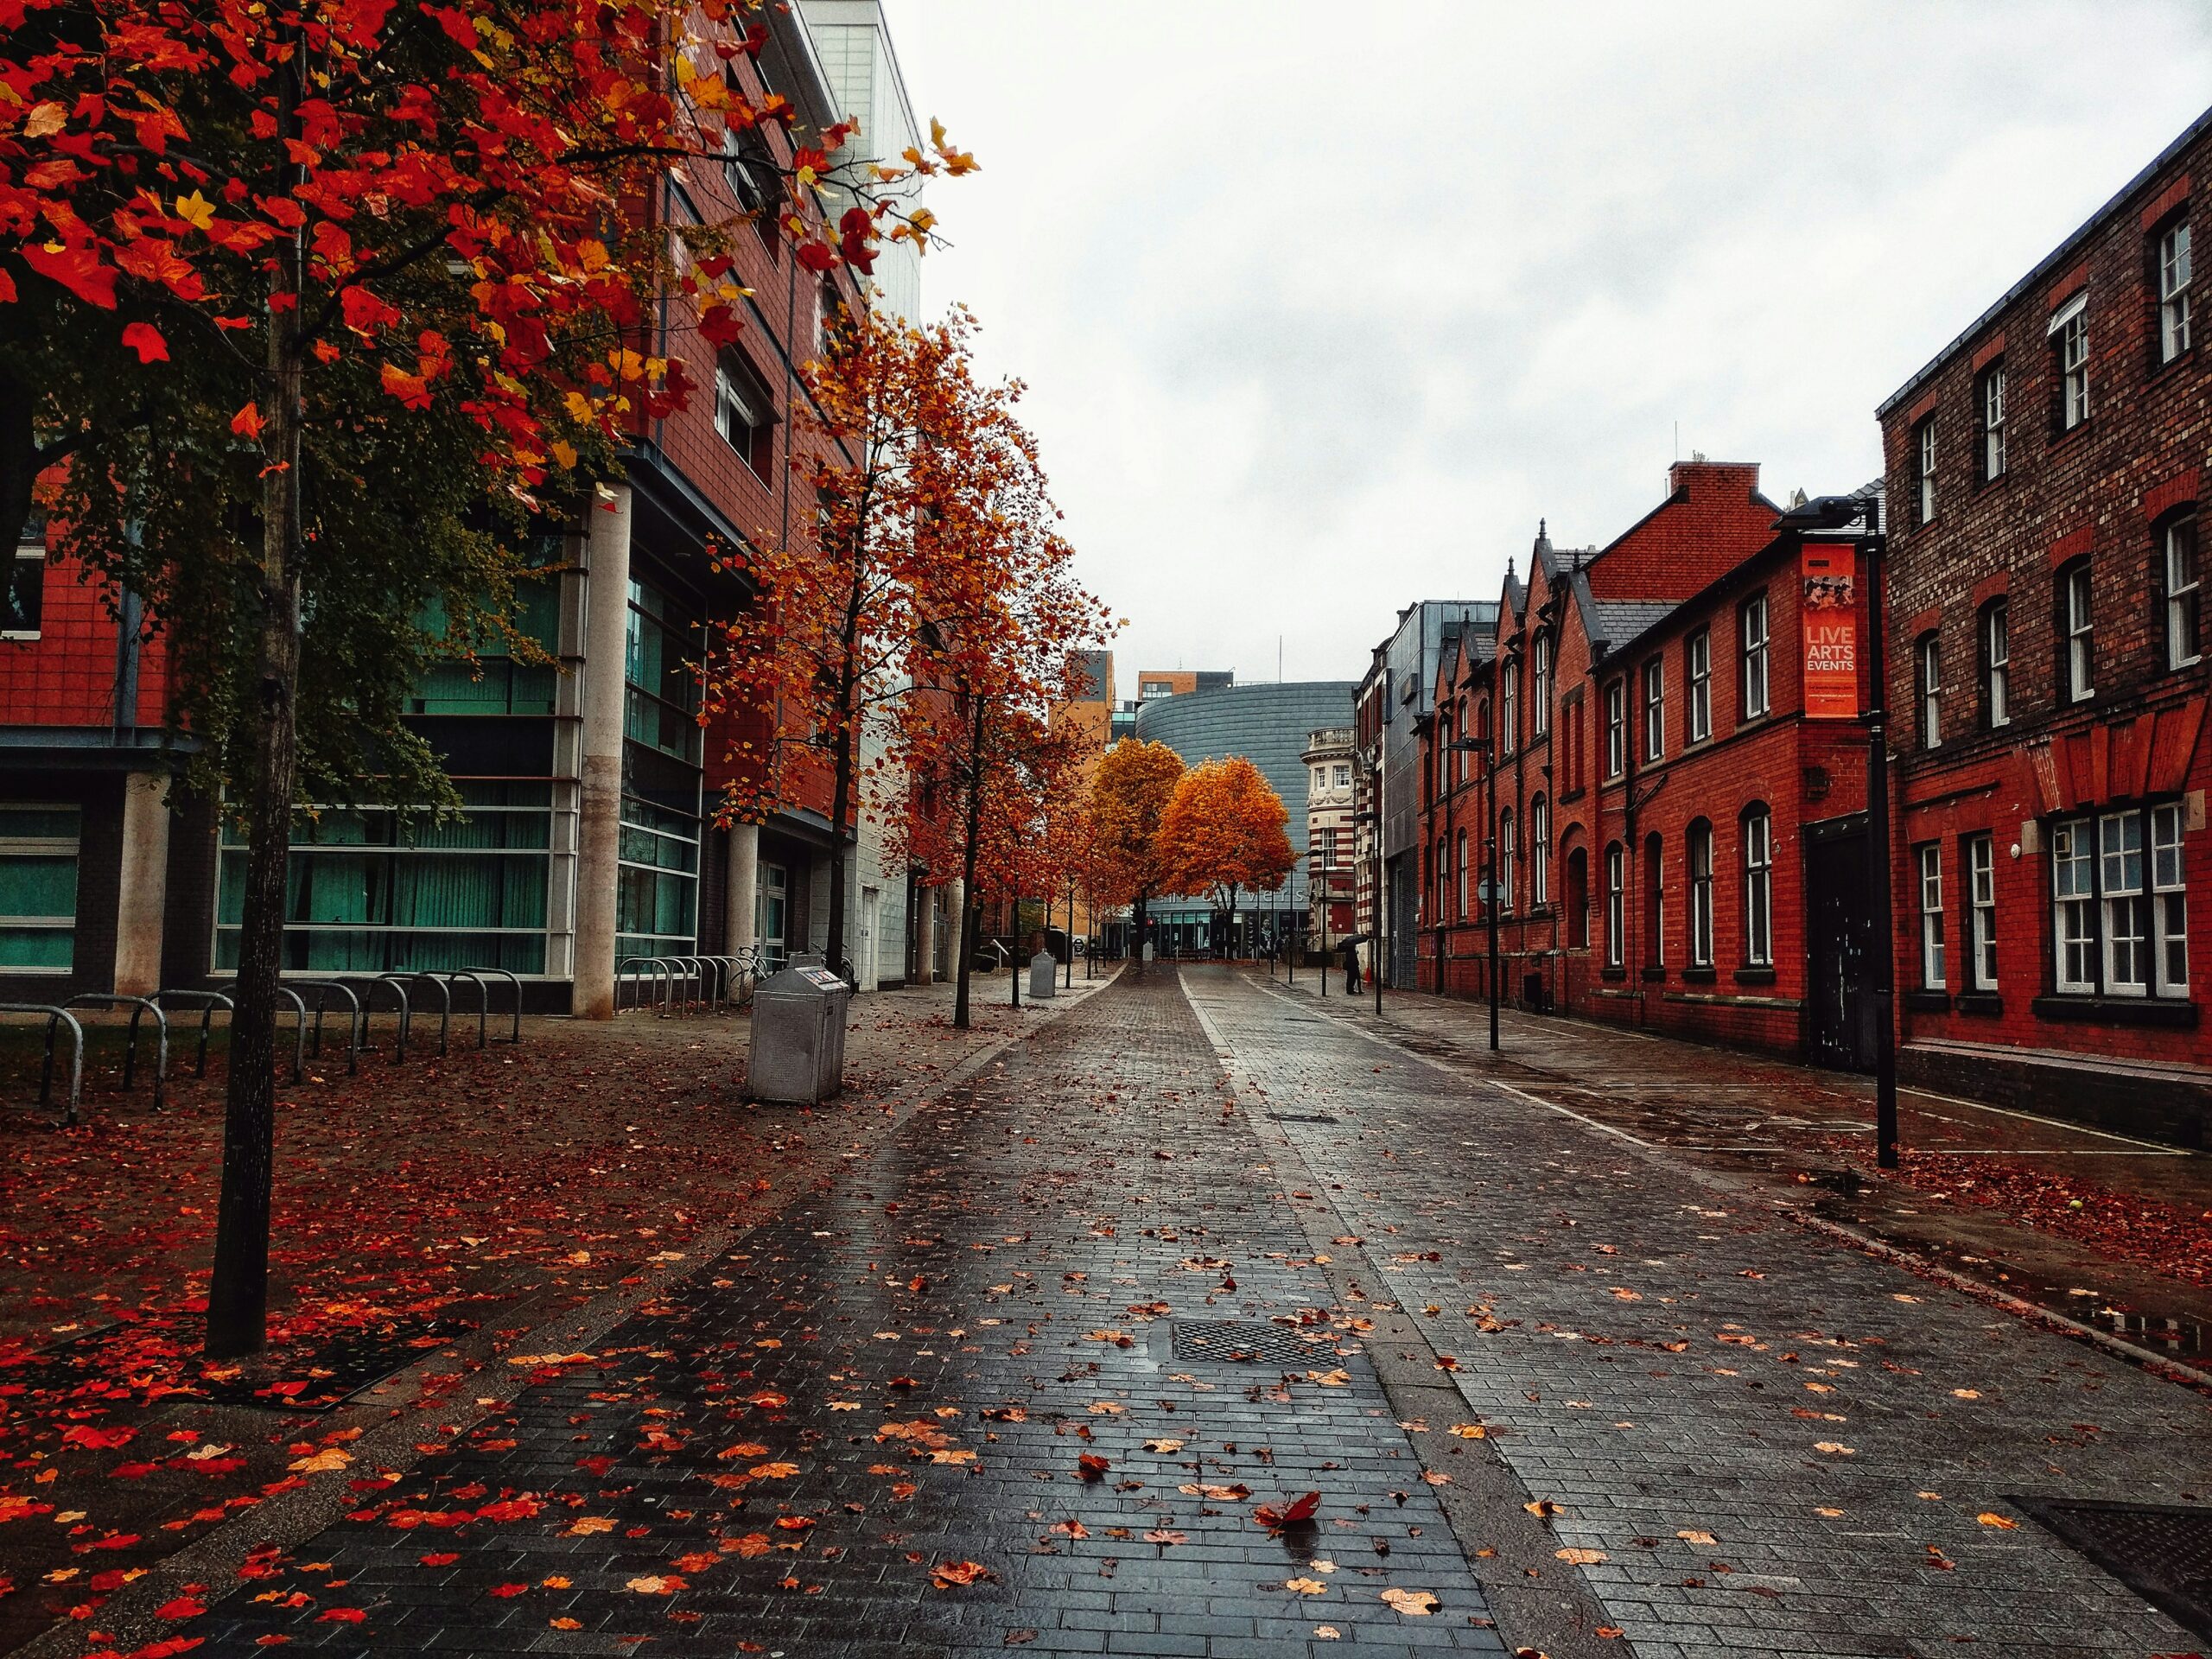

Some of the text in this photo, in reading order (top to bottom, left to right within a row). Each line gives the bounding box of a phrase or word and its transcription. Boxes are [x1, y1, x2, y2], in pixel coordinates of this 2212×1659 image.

[1807, 626, 1854, 644] LIVE
[1808, 645, 1854, 660] ARTS
[1808, 660, 1854, 671] EVENTS
